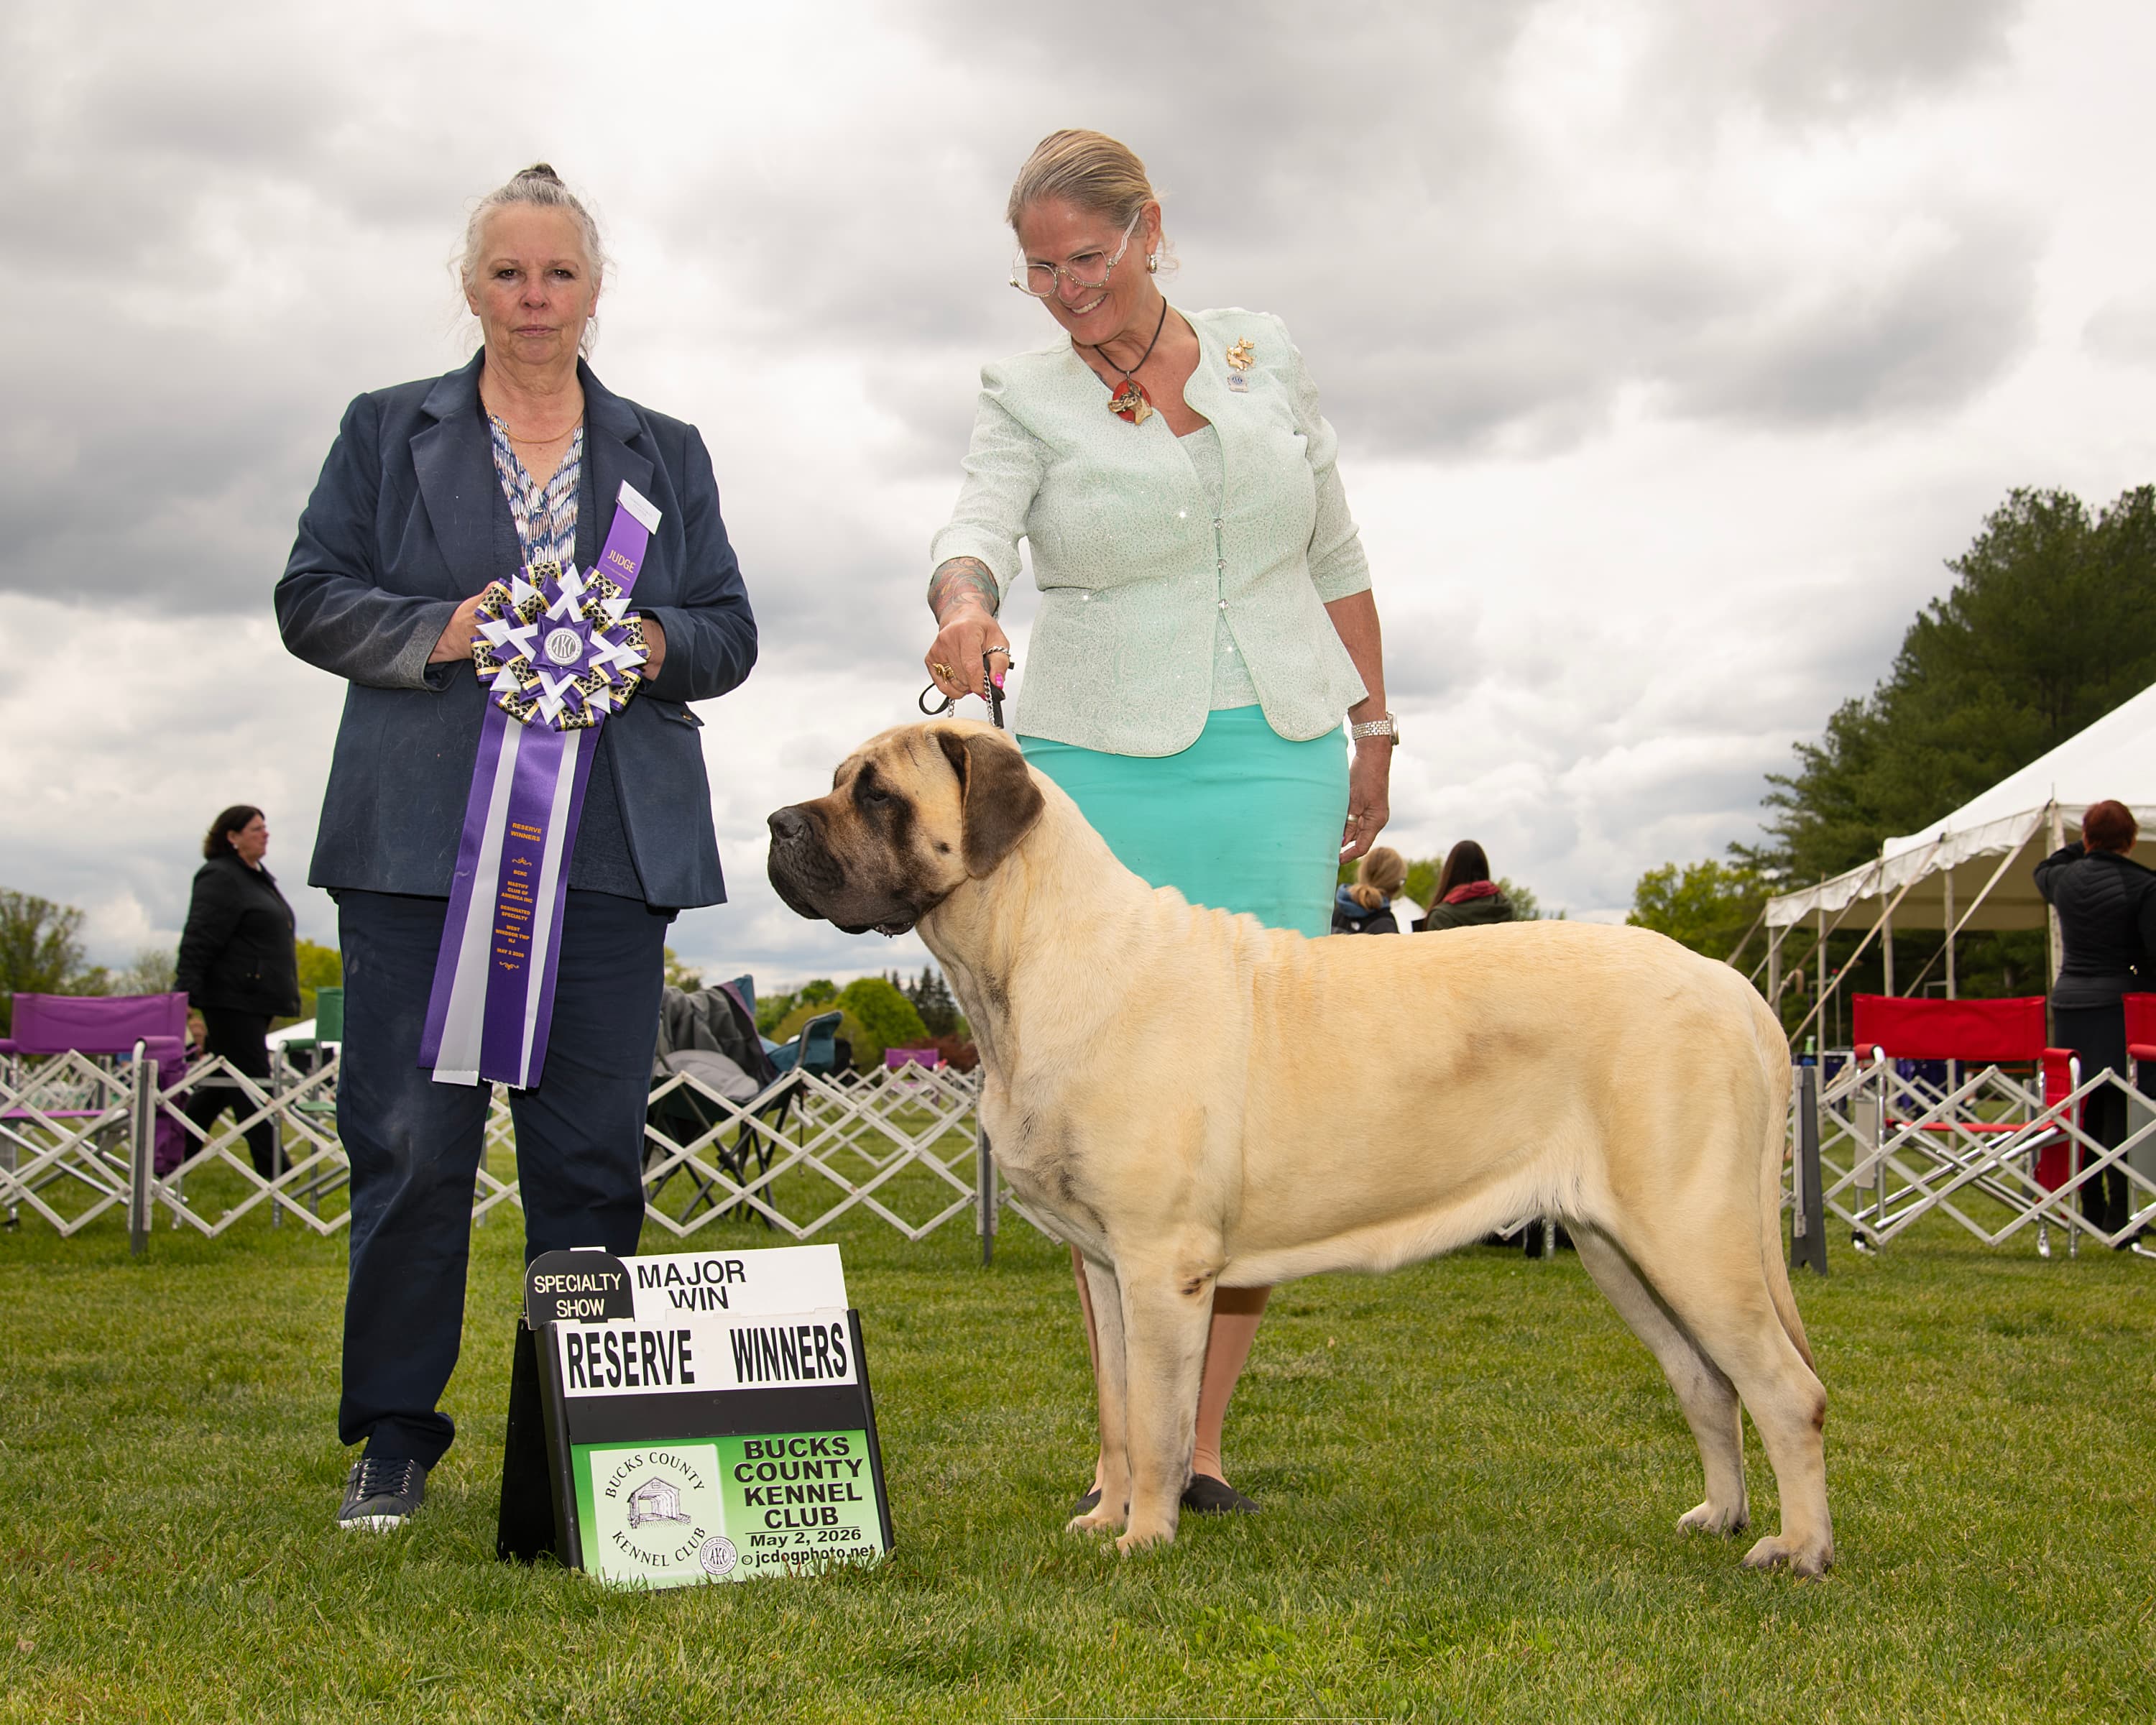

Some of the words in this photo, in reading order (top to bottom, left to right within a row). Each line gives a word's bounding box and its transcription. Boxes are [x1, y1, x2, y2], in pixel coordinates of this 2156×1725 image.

[607, 549, 636, 574] JUDGE
[552, 635, 576, 658] AKC
[510, 830, 540, 842] WINNERS
[512, 822, 542, 834] RESERVE
[507, 880, 528, 889] MASTIFF
[501, 892, 523, 901] AMERICA
[500, 904, 530, 915] DESIGNATED
[501, 911, 528, 921] SPECIALTY
[495, 929, 518, 938] WINDSOR
[534, 1273, 622, 1294] SPECIALTY
[637, 1259, 746, 1289] MAJOR
[556, 1298, 605, 1317] SHOW
[668, 1286, 729, 1312] WIN
[566, 1329, 695, 1389] RESERVE
[729, 1322, 847, 1383] WINNERS
[742, 1435, 849, 1460] BUCKS
[605, 1454, 644, 1499] BUCKS
[649, 1452, 705, 1491] COUNTY
[734, 1458, 863, 1483] COUNTY
[744, 1481, 863, 1506] KENNEL
[764, 1506, 839, 1529] CLUB
[612, 1530, 670, 1567] KENNEL
[675, 1527, 706, 1562] CLUB
[750, 1535, 788, 1548] May
[794, 1532, 811, 1545] 2,
[817, 1529, 862, 1543] 2026
[710, 1547, 728, 1565] AKC
[755, 1544, 875, 1568] jcdogphoto.net
